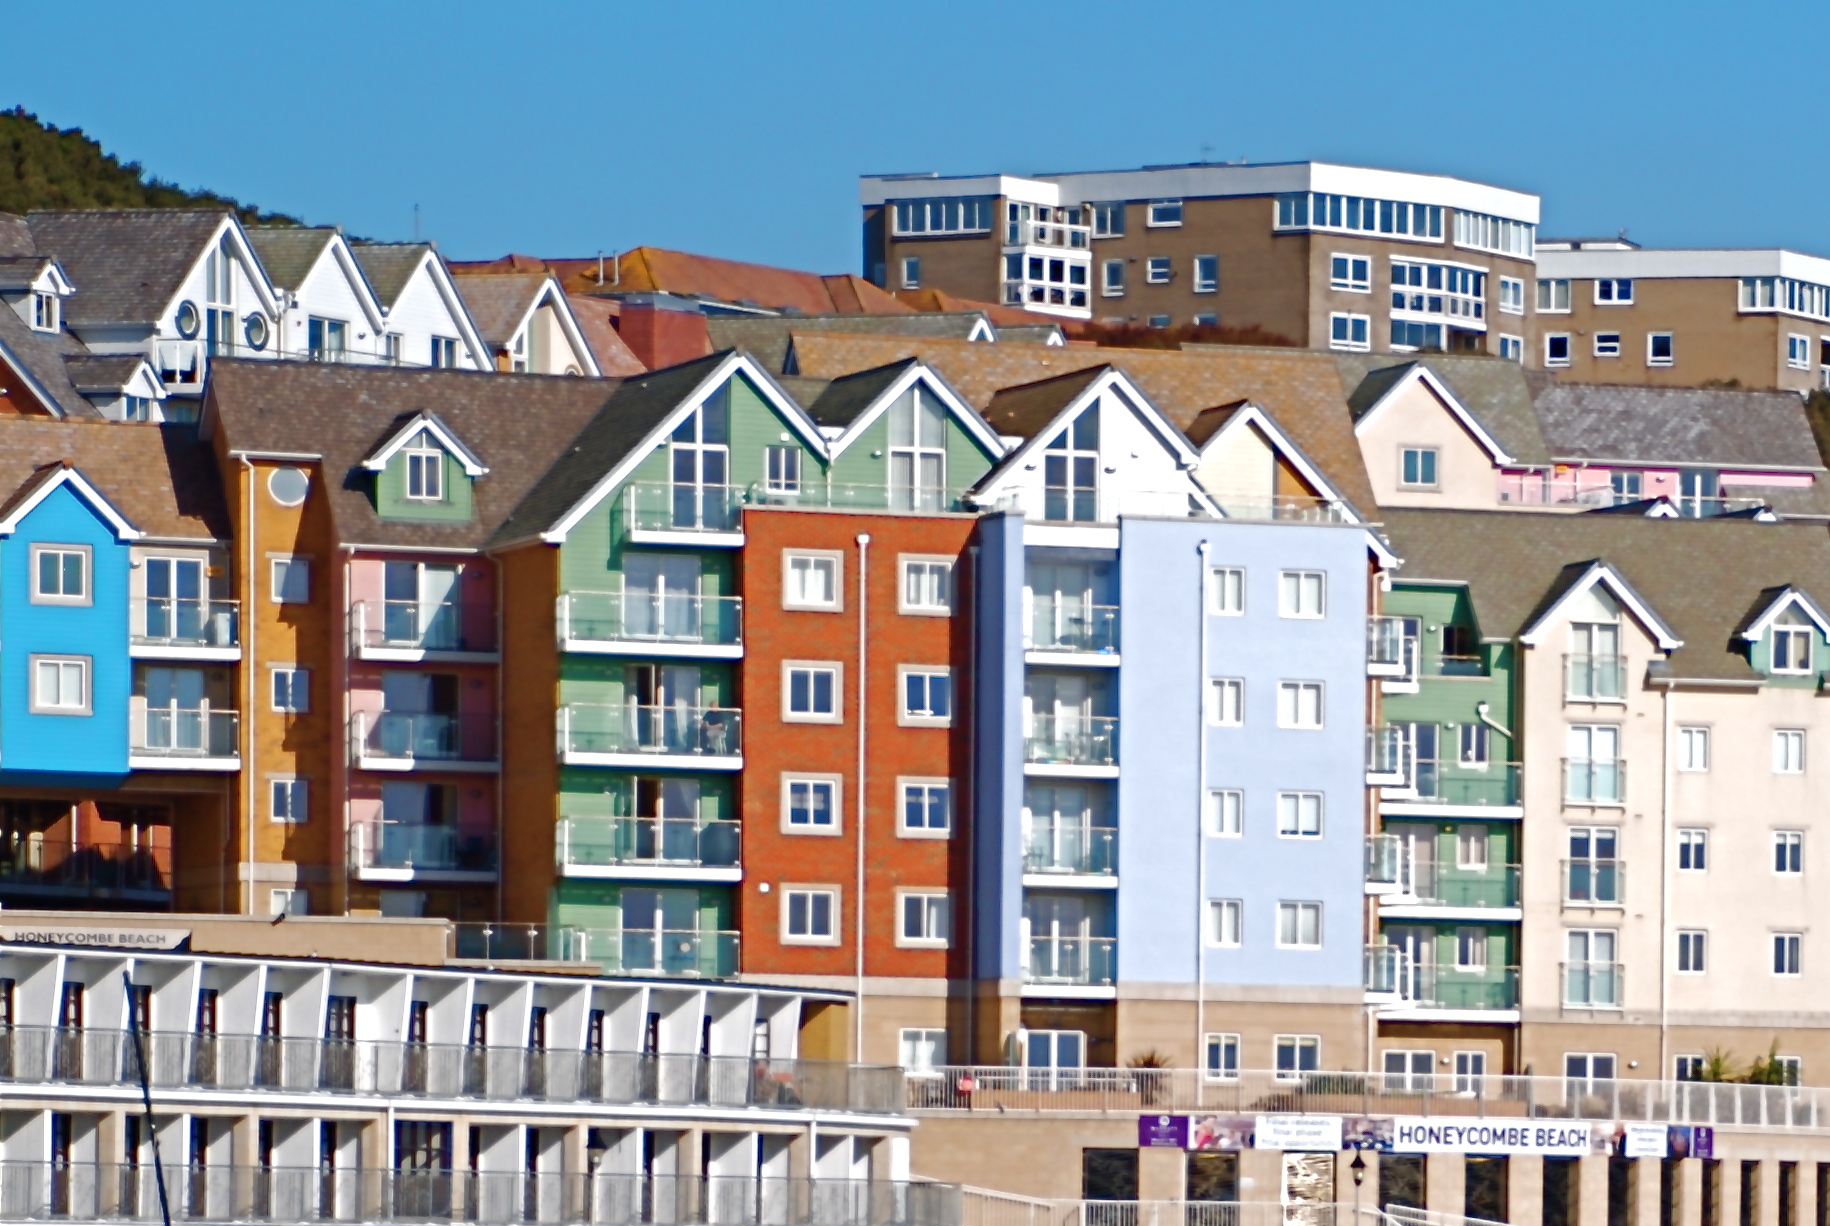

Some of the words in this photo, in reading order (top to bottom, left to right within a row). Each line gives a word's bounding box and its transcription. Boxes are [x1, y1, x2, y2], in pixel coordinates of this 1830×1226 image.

[14, 931, 114, 944] HONEYCOMBE
[118, 934, 166, 944] BEACH
[1399, 1125, 1529, 1147] HONEYCOMBE
[1535, 1127, 1587, 1148] BEACH
